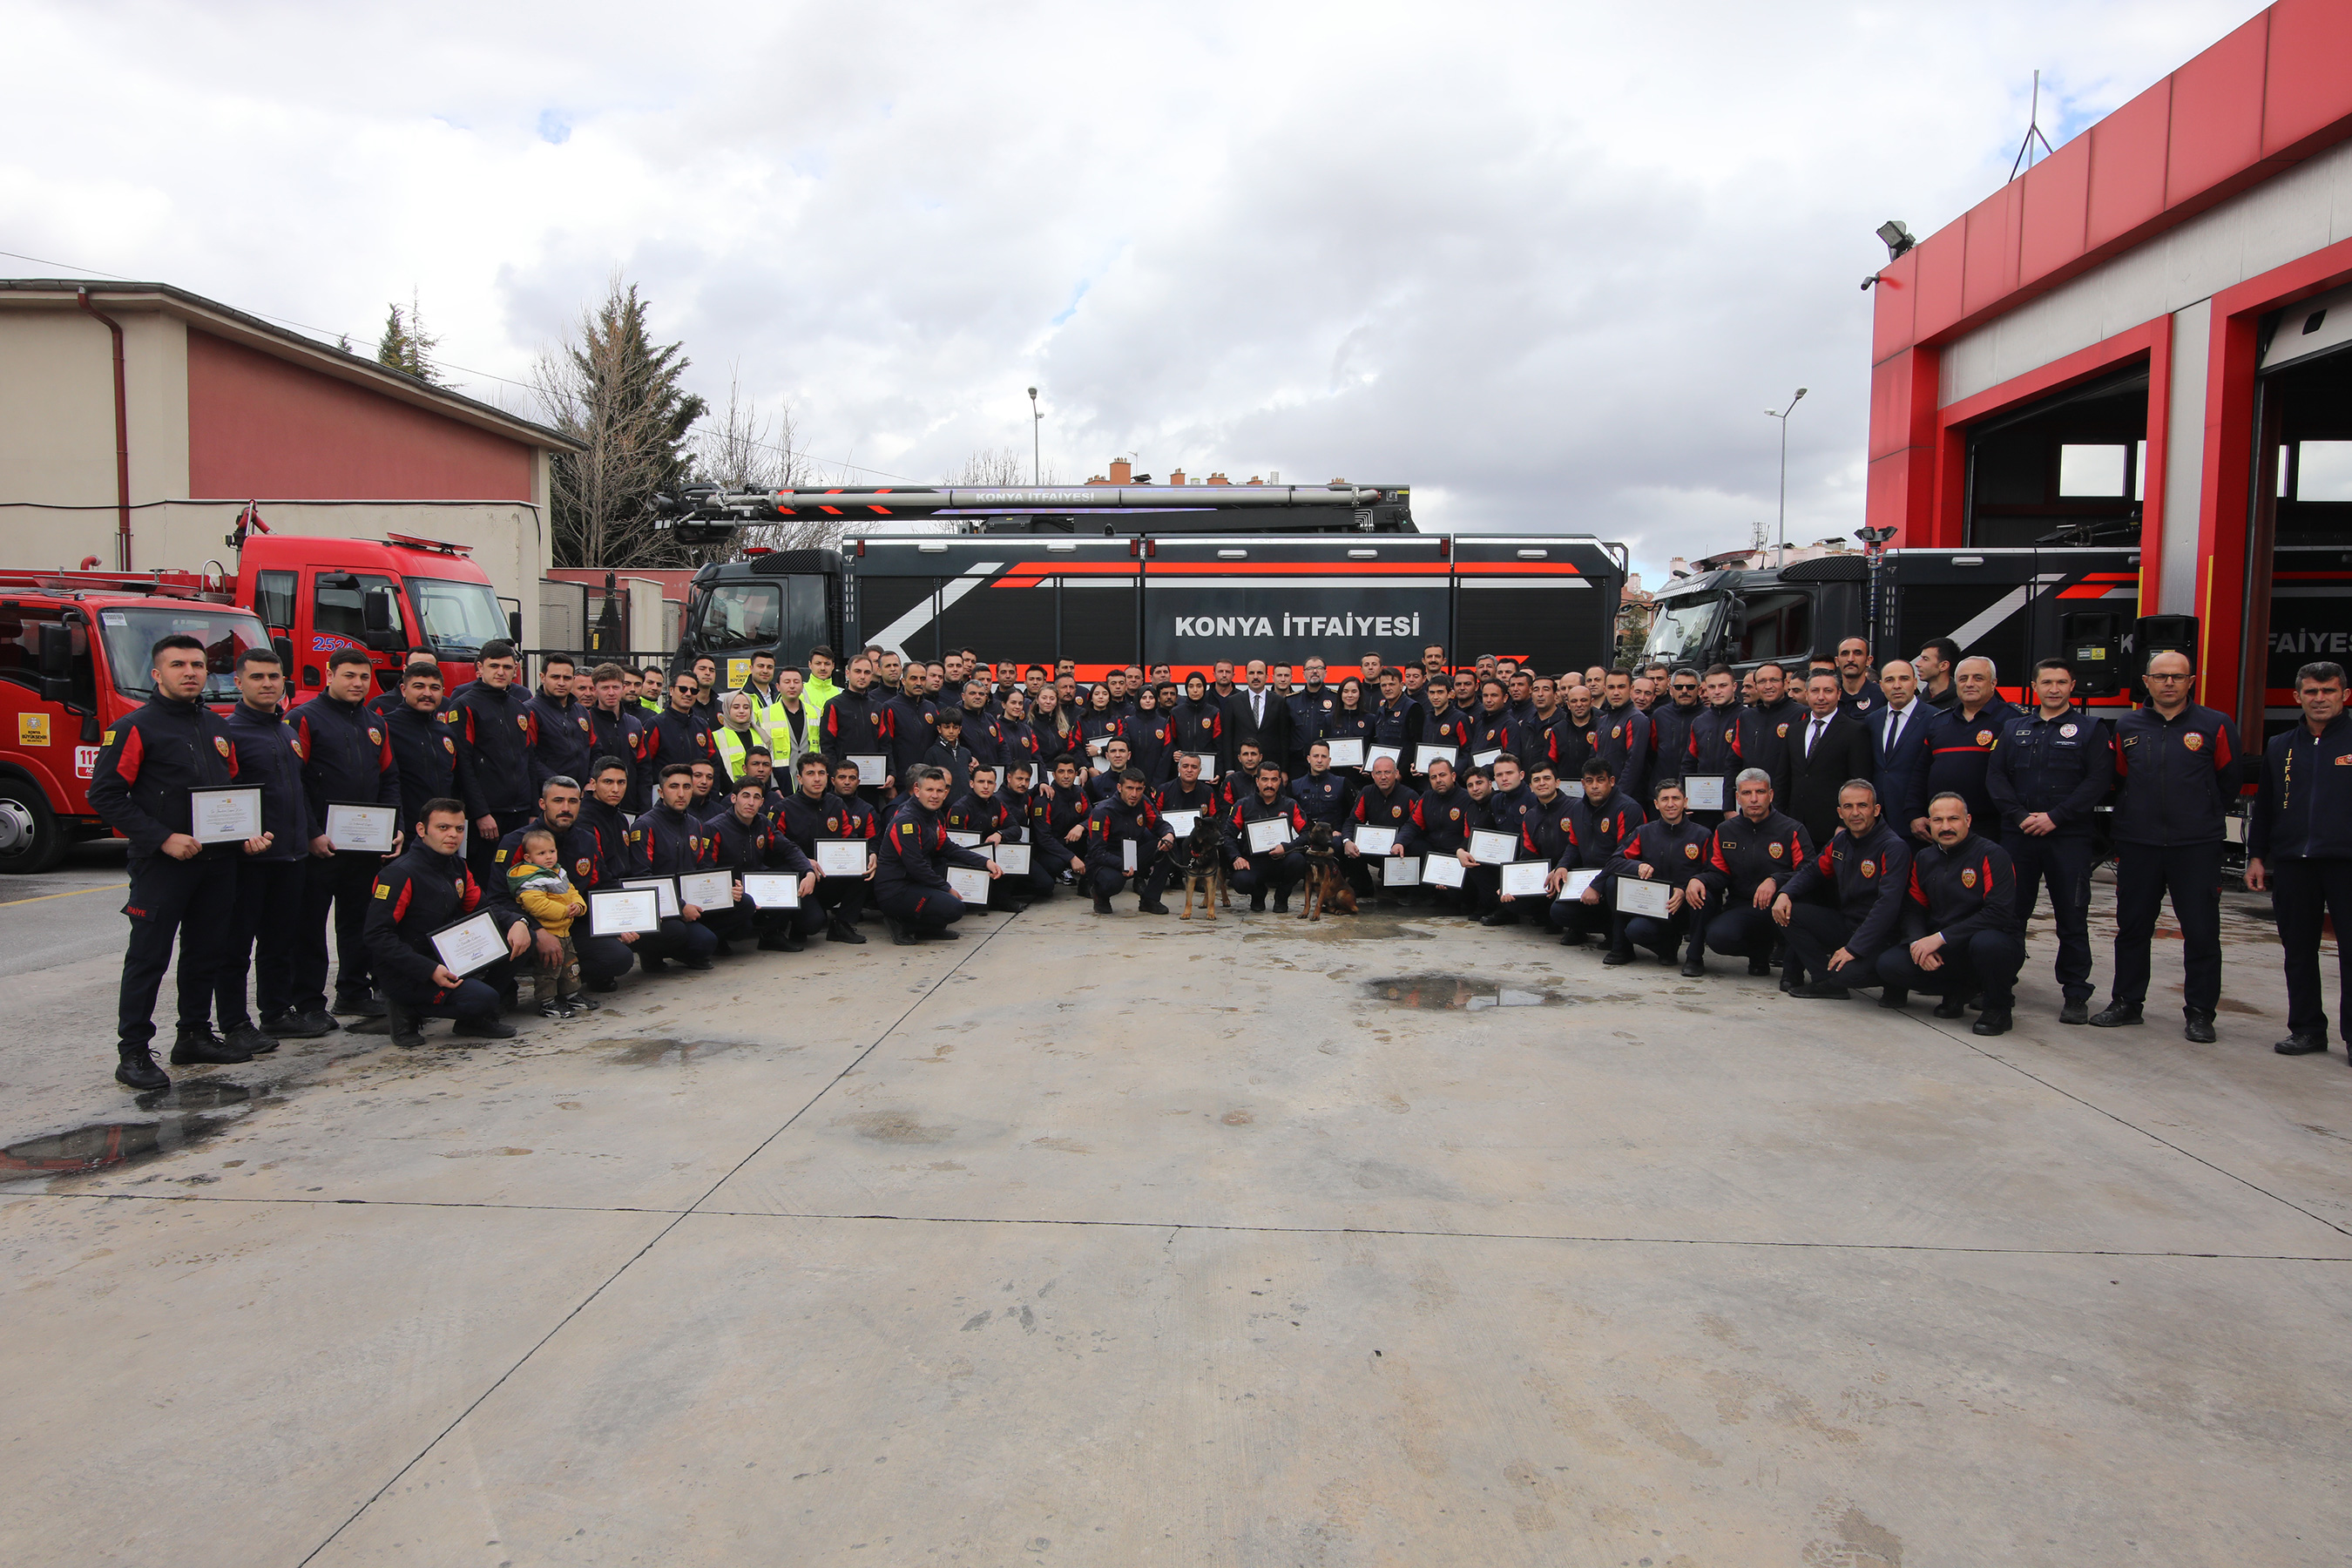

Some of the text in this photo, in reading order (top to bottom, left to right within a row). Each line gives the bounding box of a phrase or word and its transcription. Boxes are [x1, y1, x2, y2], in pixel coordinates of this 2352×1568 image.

[976, 492, 1095, 503] KONYA İTFAİYESİ
[1175, 612, 1420, 637] KONYA İTFAİYESİ
